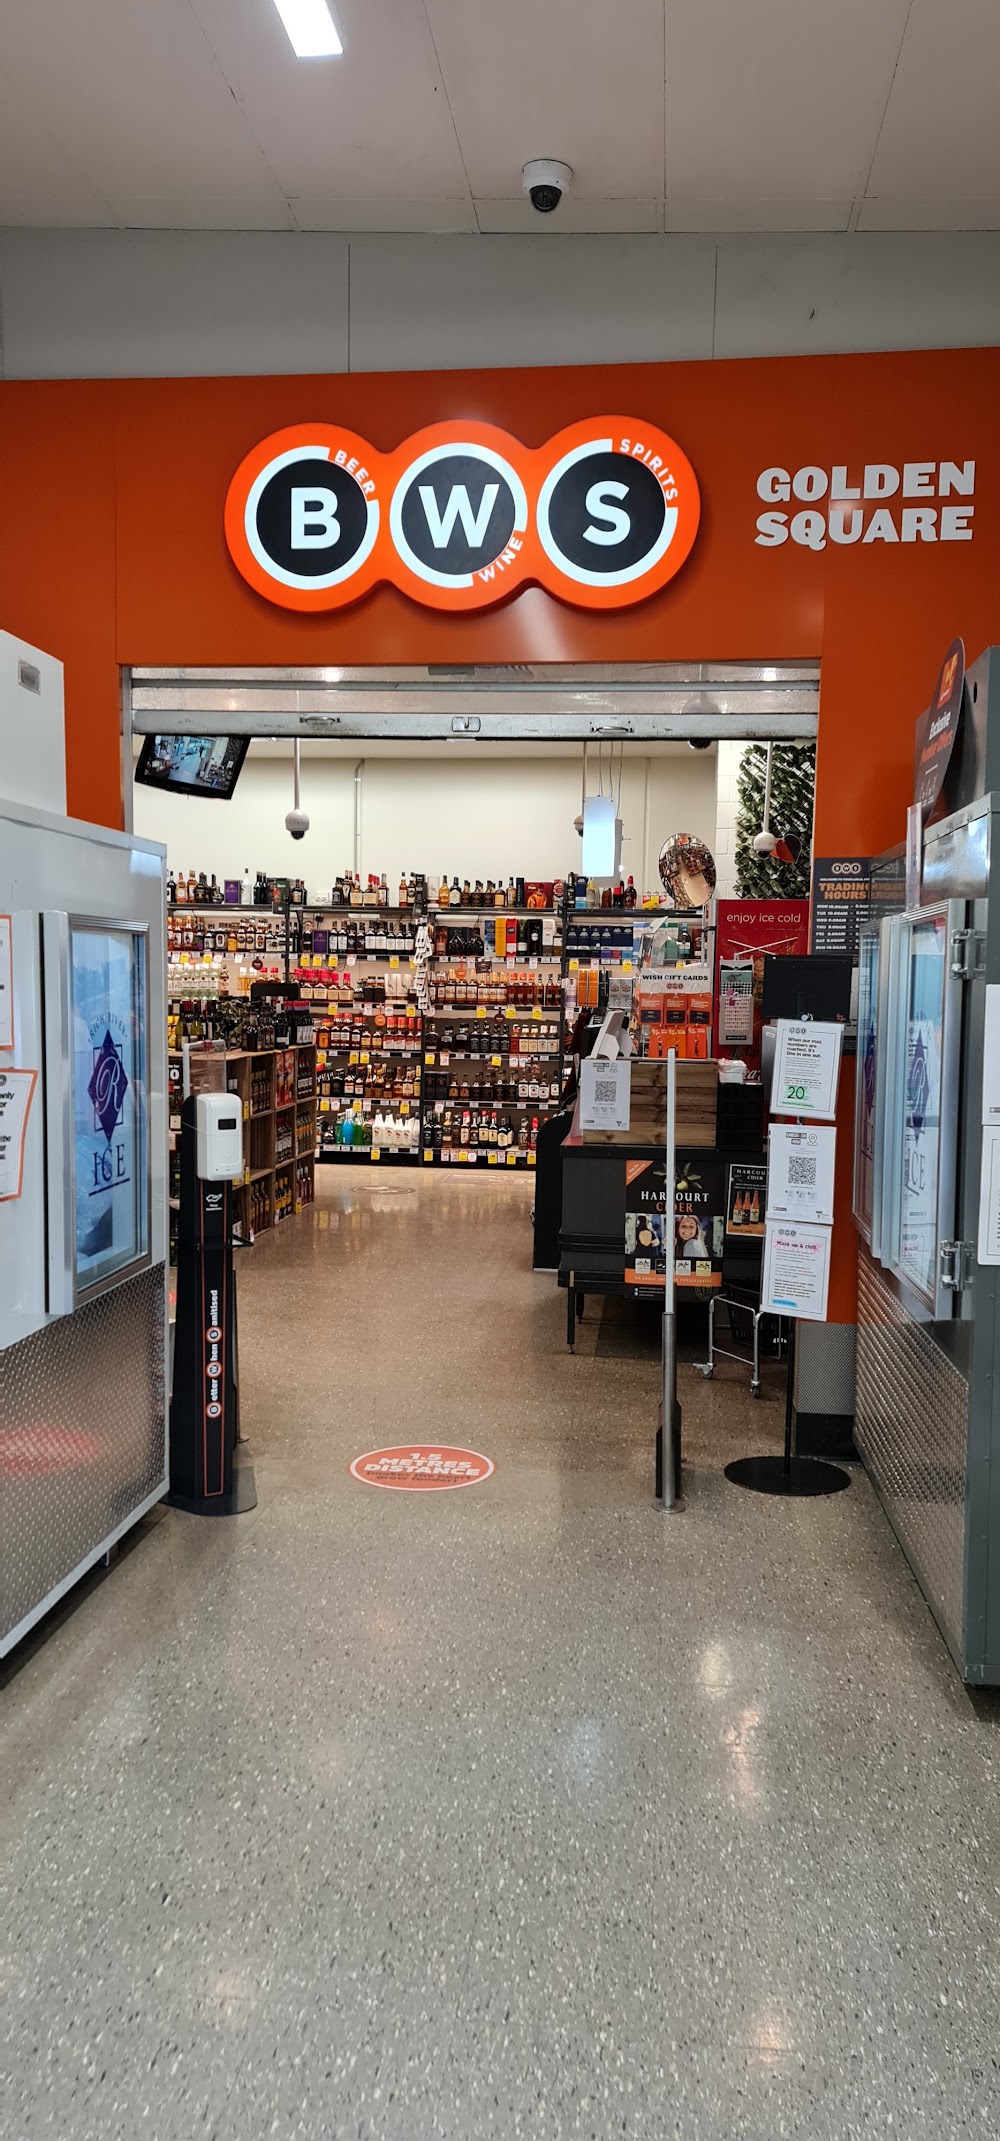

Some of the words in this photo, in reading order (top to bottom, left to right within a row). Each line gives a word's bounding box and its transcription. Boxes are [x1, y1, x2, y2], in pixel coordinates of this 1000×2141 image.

[333, 449, 376, 494] BEER
[619, 438, 678, 502] SPIRITS
[756, 460, 976, 503] GOLDEN
[754, 505, 975, 552] SQUARE
[478, 536, 523, 584] WINE
[823, 890, 866, 899] HOURS
[726, 912, 756, 924] enjoy
[759, 913, 775, 923] ice
[777, 913, 801, 923] cold
[787, 1086, 805, 1100] 20
[93, 1143, 126, 1187] ICE
[641, 1191, 709, 1202] HAROURT
[656, 1201, 693, 1213] CER
[363, 1464, 480, 1476] DISTANCE
[379, 1458, 472, 1468] METRES
